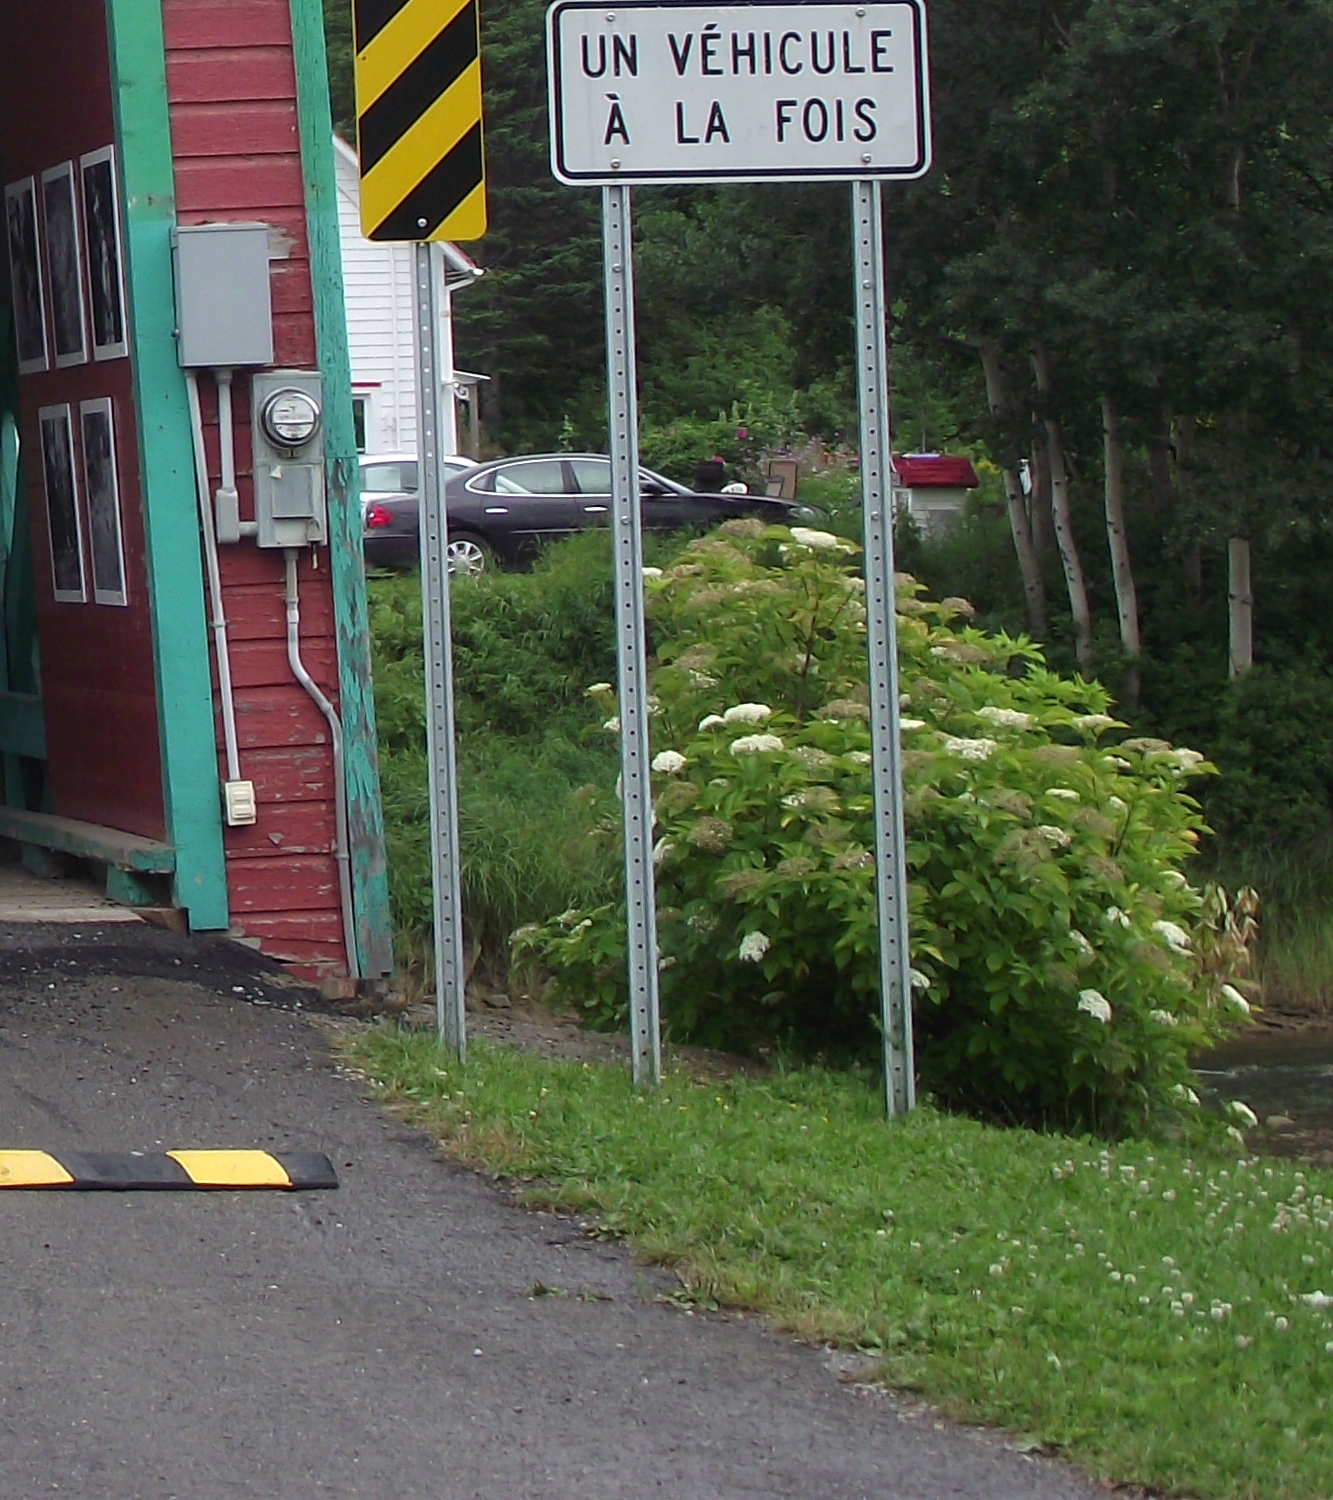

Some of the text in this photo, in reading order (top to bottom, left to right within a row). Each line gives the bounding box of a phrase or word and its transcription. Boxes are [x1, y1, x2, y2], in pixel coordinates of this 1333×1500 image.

[581, 23, 895, 78] UN VÉHICULE
[604, 93, 878, 146] À LA FOIS
